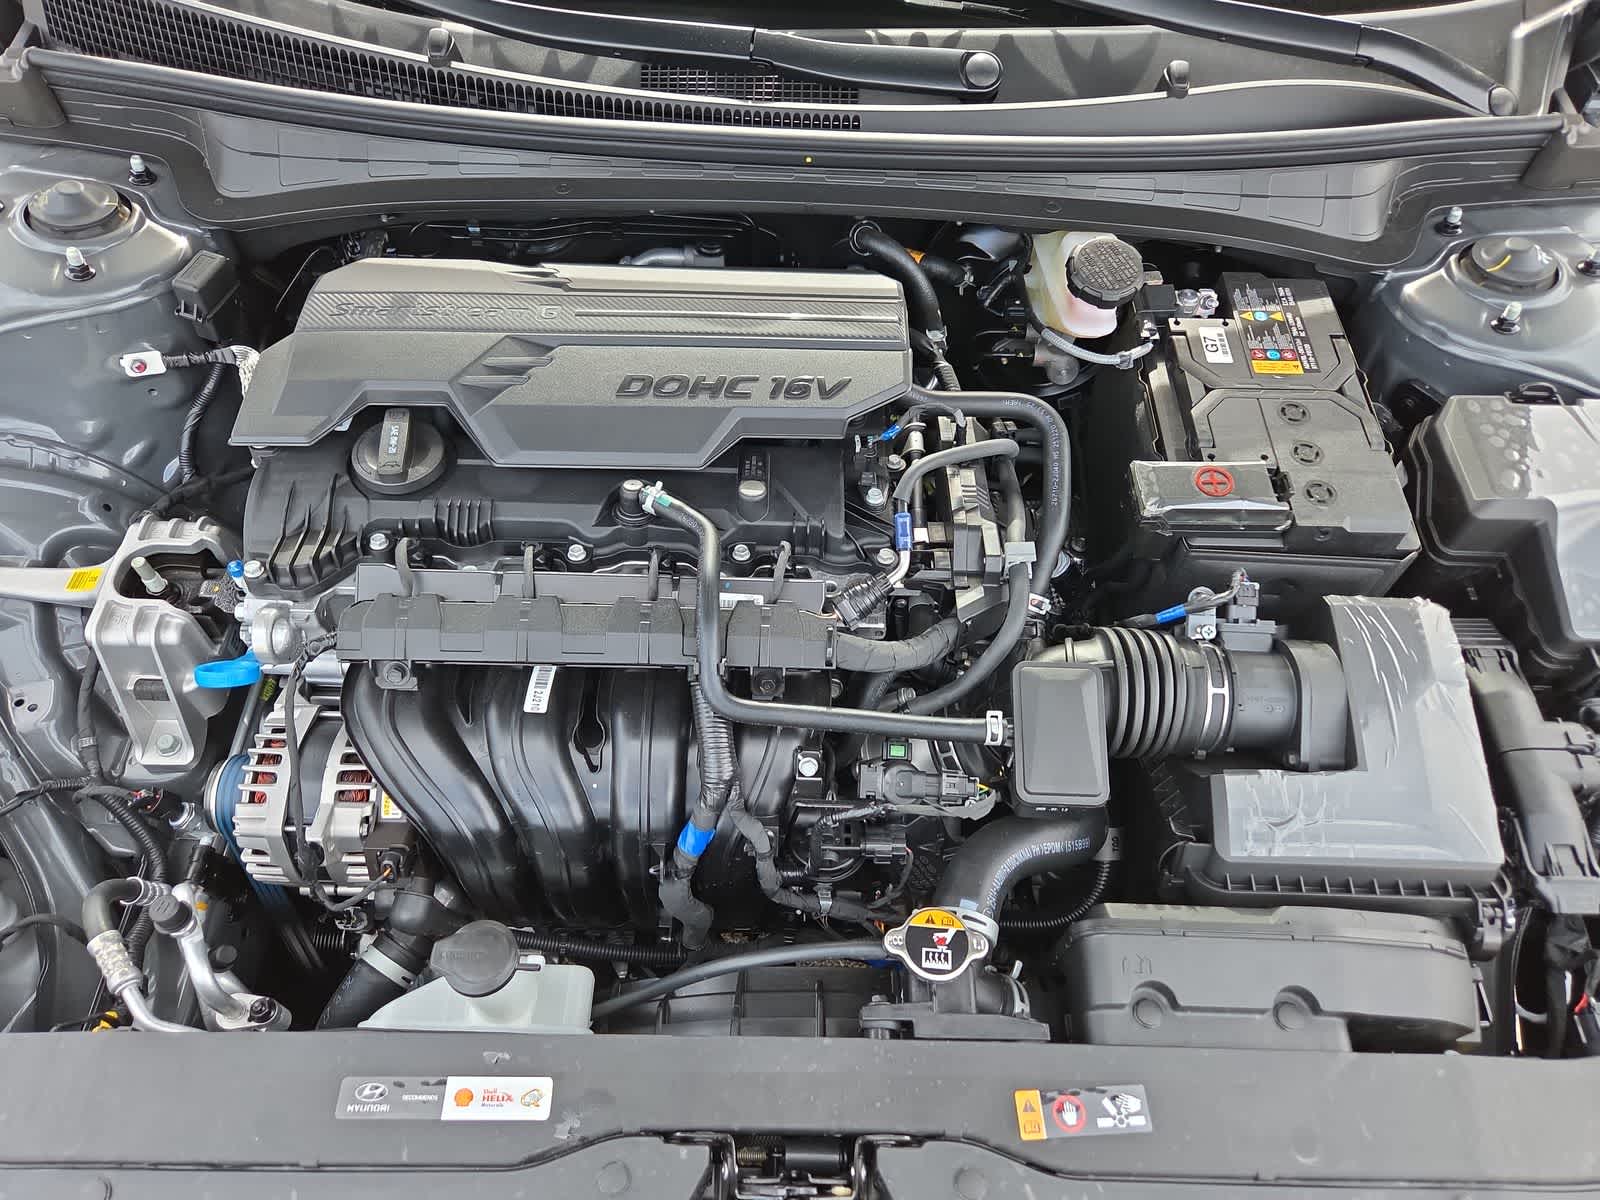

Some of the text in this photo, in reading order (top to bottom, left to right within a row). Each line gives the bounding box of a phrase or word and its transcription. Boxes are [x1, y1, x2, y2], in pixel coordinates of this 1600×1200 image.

[1202, 335, 1219, 353] G7
[615, 373, 852, 401] DOHC 16V
[346, 1103, 390, 1113] HYUNDAI
